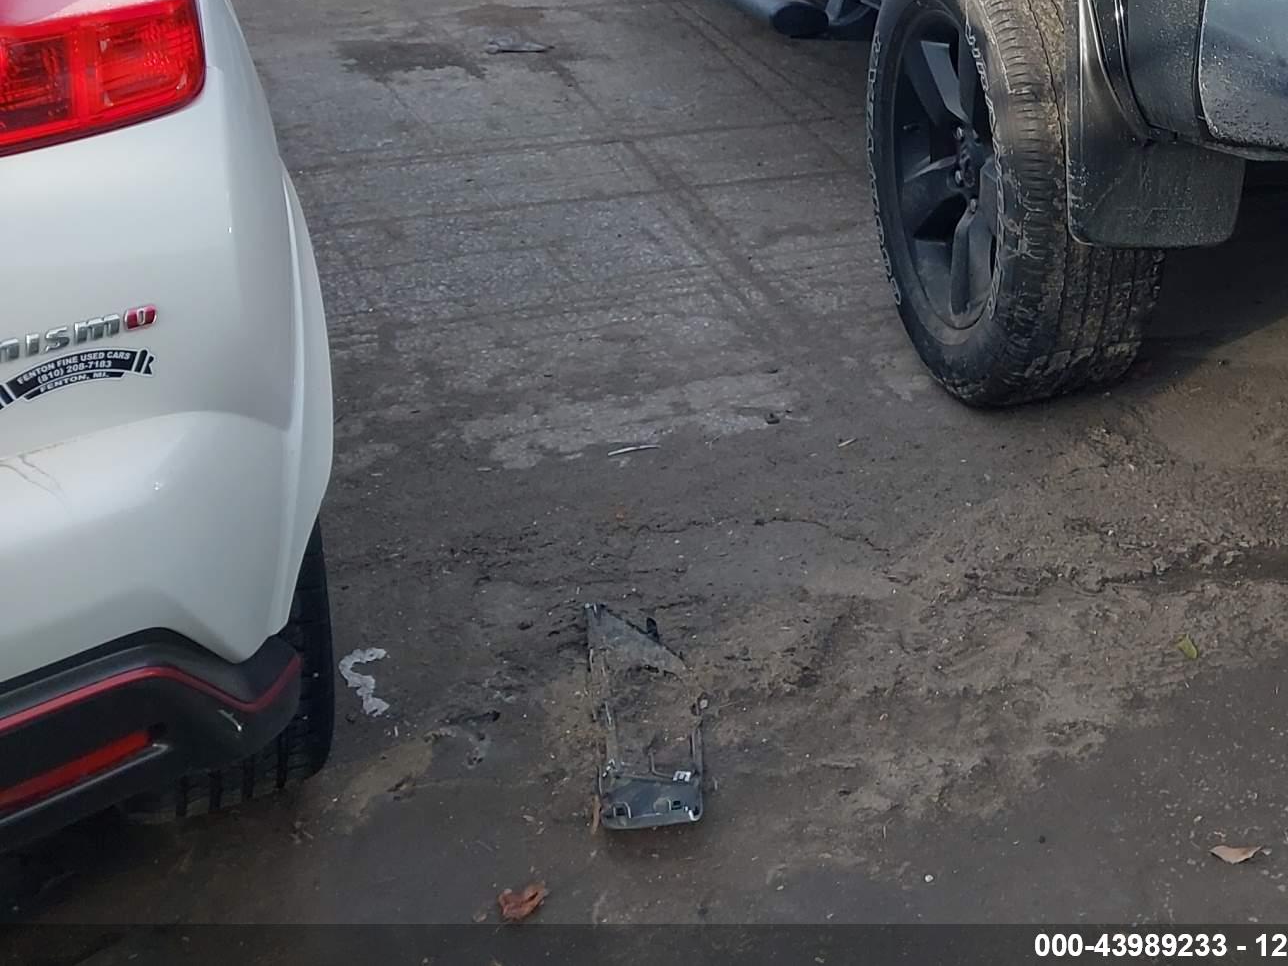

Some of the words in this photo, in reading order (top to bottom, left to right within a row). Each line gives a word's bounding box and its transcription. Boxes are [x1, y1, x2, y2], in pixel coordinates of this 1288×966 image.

[17, 362, 55, 385] FENTON
[57, 355, 78, 368] FINE
[80, 352, 105, 362] USED
[106, 351, 131, 360] CARS
